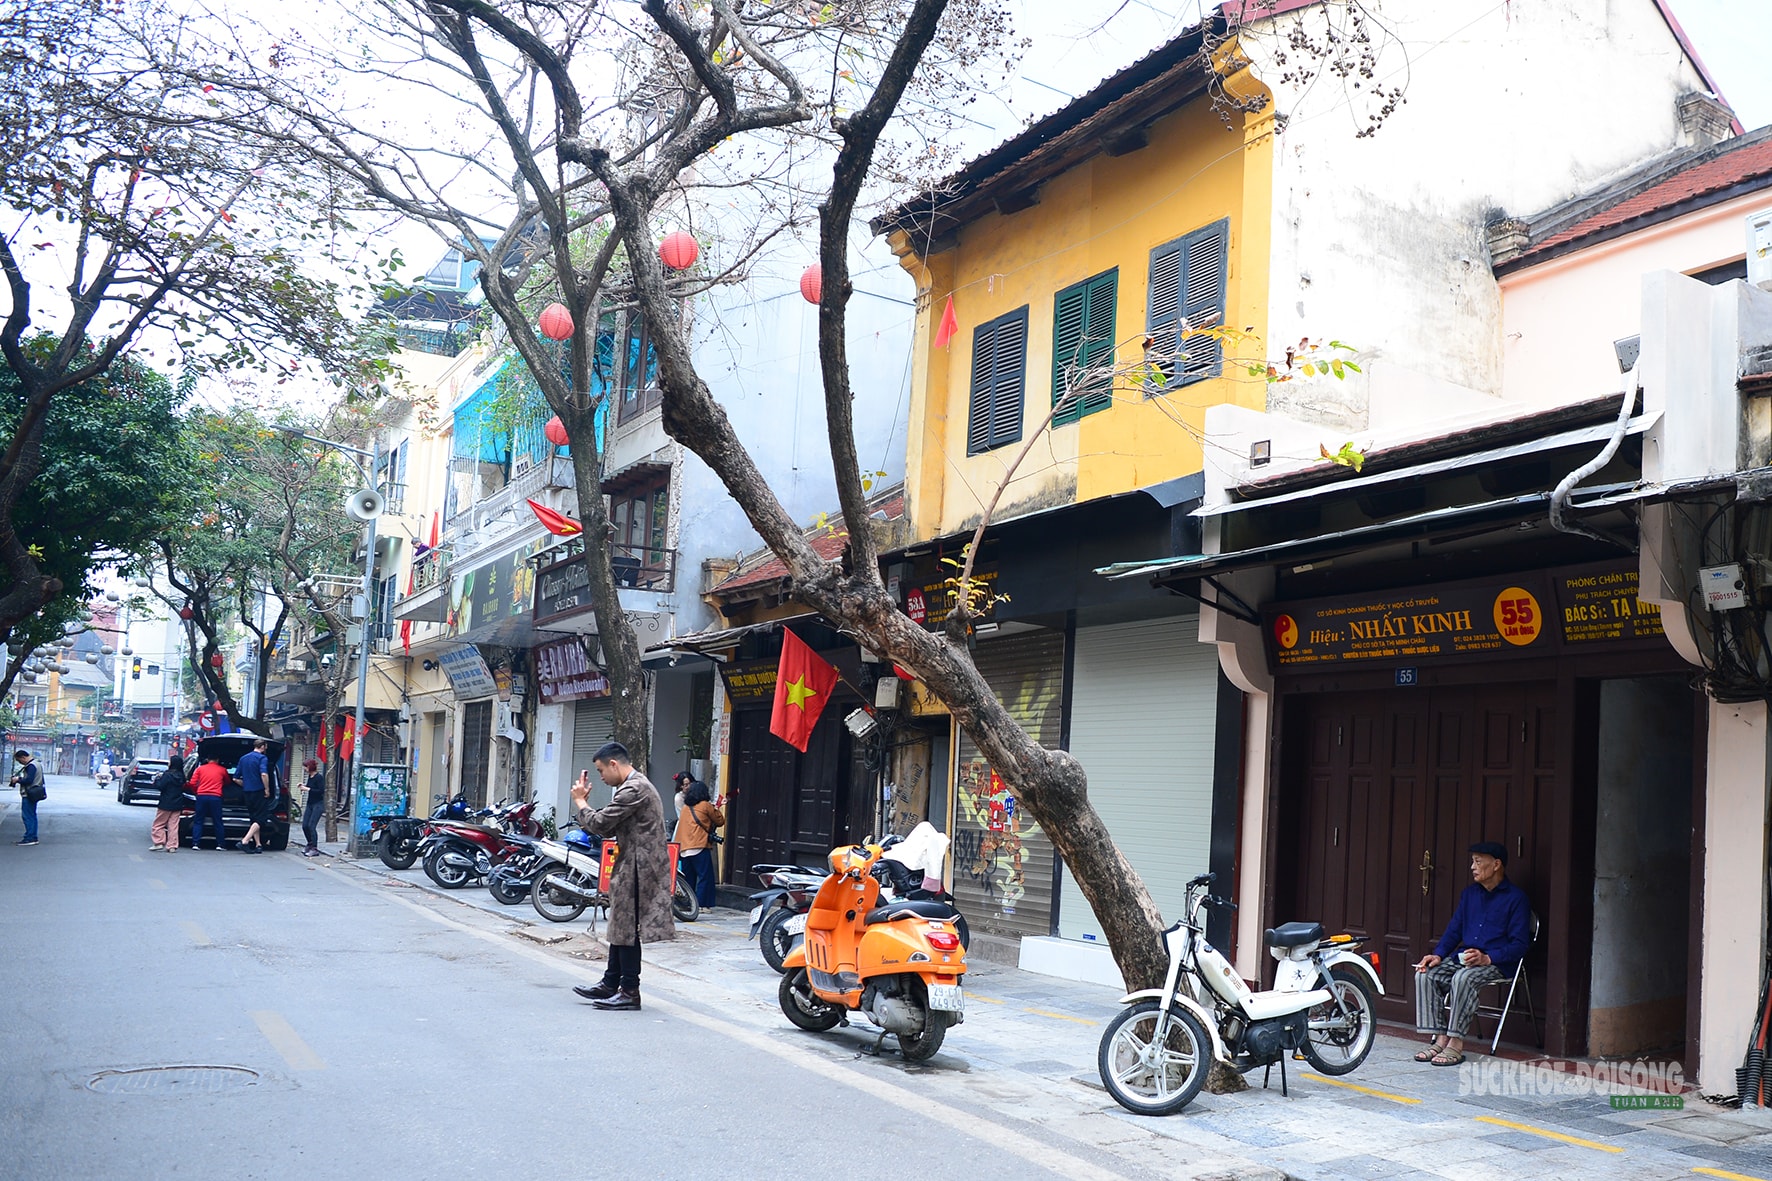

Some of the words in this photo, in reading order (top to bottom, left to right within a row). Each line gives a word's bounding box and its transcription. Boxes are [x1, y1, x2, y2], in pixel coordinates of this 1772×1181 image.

[1566, 577, 1597, 588] PHÒNG
[908, 595, 925, 612] 53A
[1709, 592, 1738, 602] 19001515
[1347, 606, 1367, 614] DOANH
[1500, 598, 1533, 626] 55
[1565, 603, 1588, 622] BÁC
[1611, 597, 1632, 620] TẠ
[1348, 611, 1407, 640] NHẤT
[1411, 610, 1473, 635] KINH
[1400, 669, 1413, 683] 55
[720, 738, 729, 754] 51
